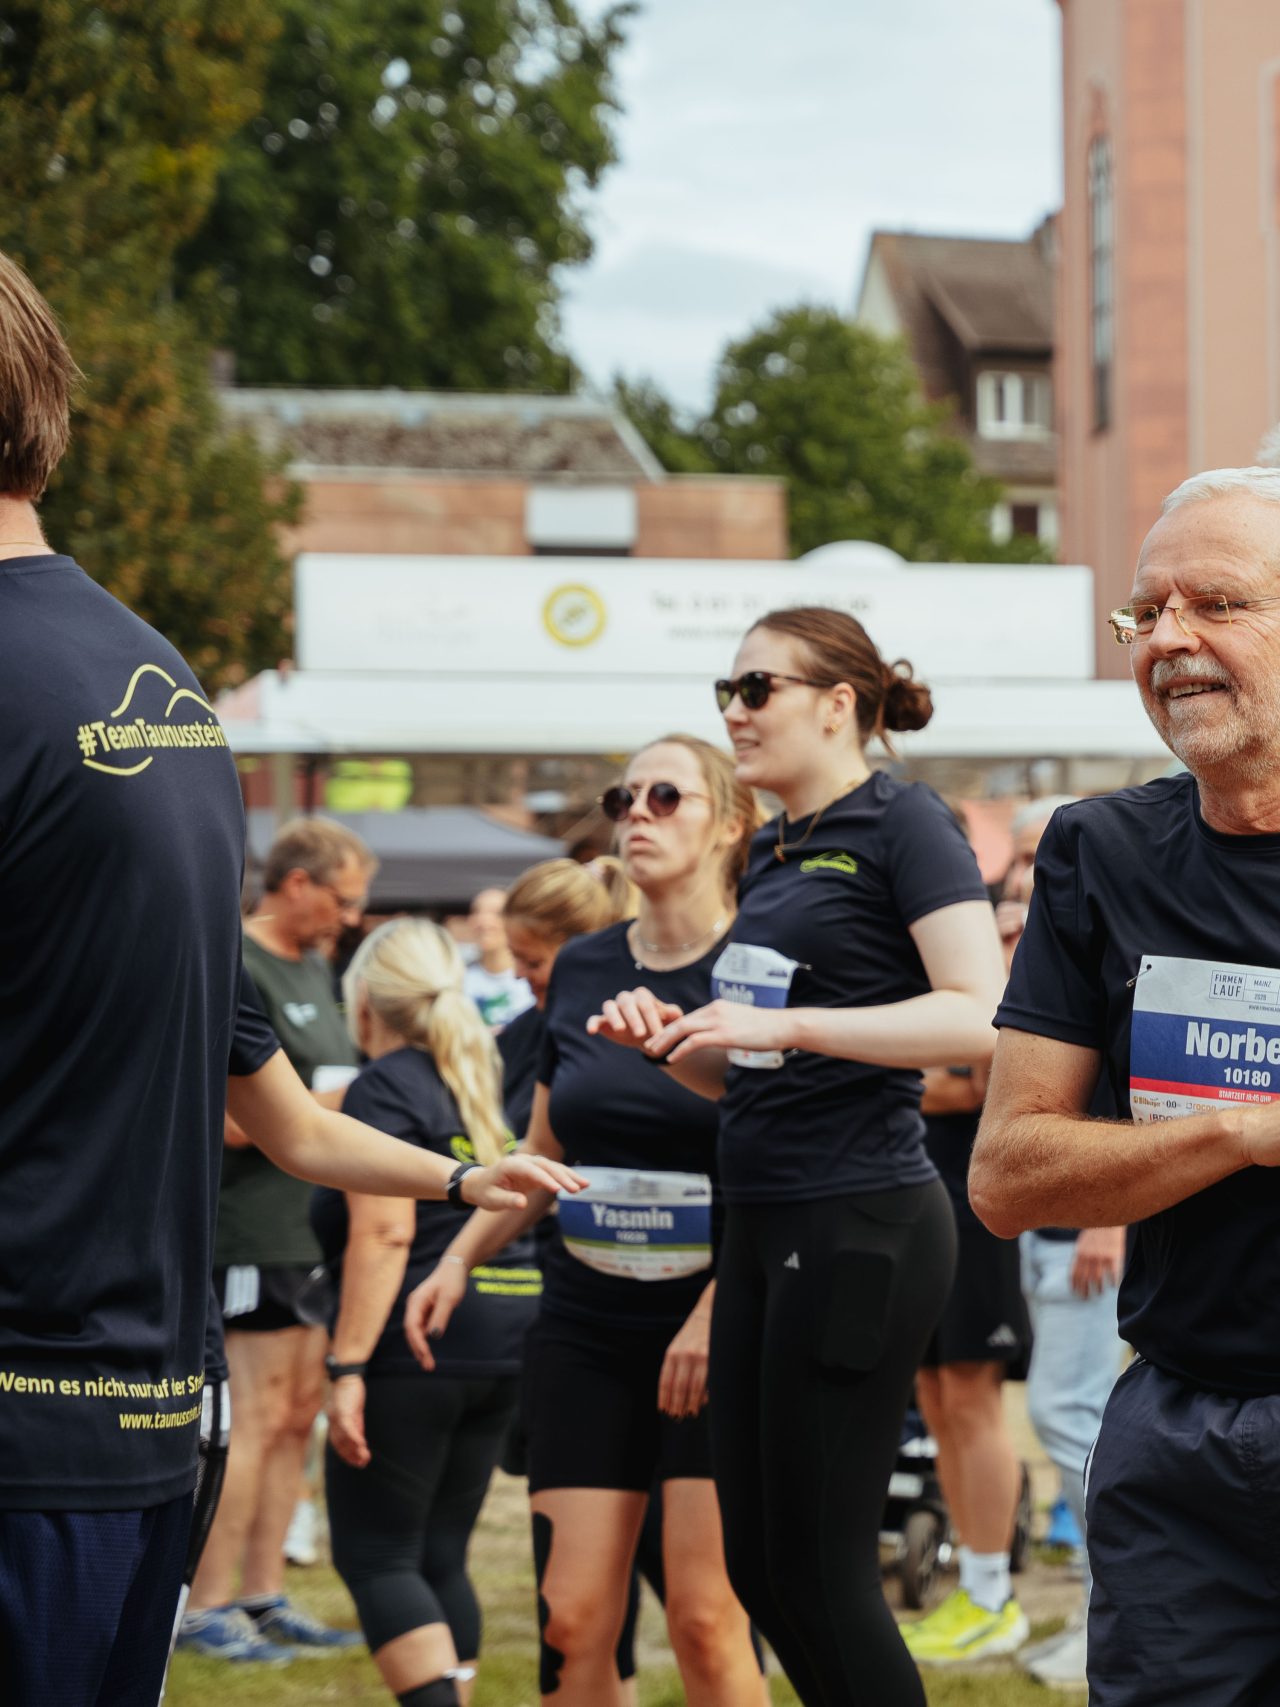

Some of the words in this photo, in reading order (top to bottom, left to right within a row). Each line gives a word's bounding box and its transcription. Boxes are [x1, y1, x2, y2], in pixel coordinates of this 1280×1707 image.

[1215, 973, 1243, 984] FIRMEN
[1253, 980, 1271, 988] MAINZ
[1213, 984, 1241, 997] LAUF
[1223, 1067, 1271, 1087] 10180
[1218, 1089, 1246, 1101] STARTZEIT
[591, 1203, 674, 1229] Yasmin
[0, 1372, 55, 1394] Wenn
[59, 1377, 80, 1396] es
[85, 1376, 129, 1397] nicht
[129, 1383, 151, 1398] nur
